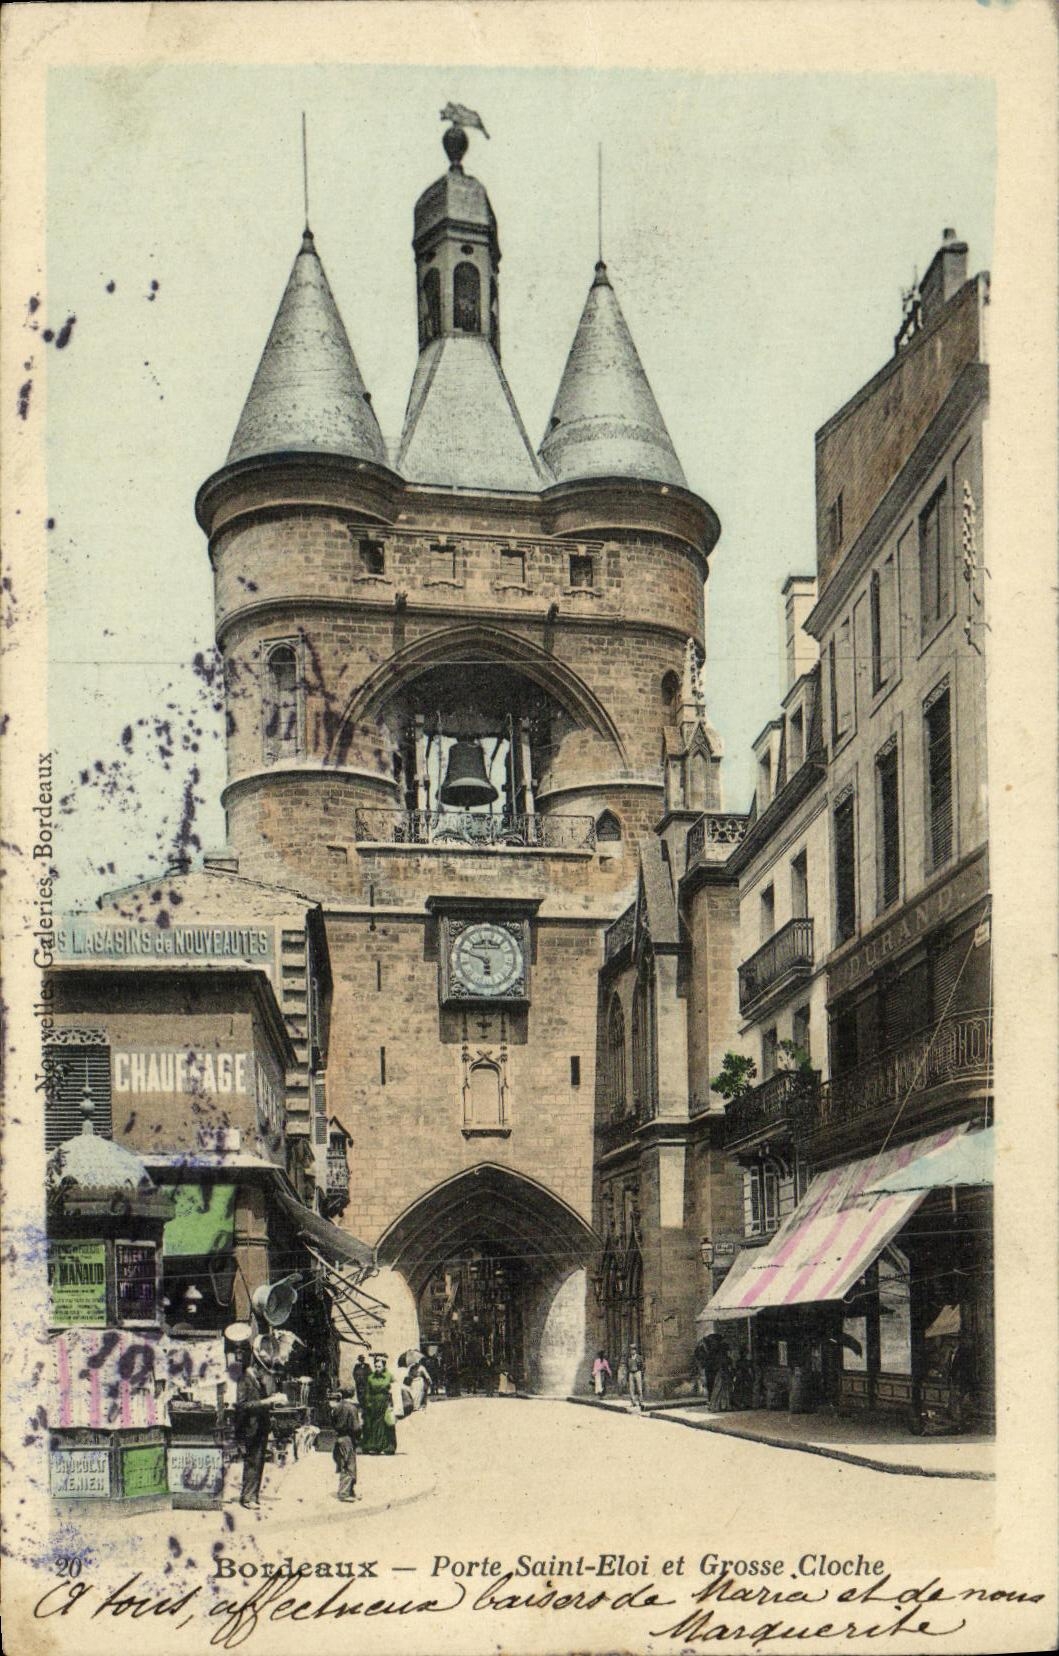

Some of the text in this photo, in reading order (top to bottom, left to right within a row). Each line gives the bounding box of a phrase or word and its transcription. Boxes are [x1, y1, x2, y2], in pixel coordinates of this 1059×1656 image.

[156, 934, 171, 953] de
[472, 1571, 606, 1610] baisers
[611, 1583, 676, 1610] de
[691, 1570, 828, 1605] Maria
[837, 1574, 897, 1603] et
[898, 1577, 955, 1604] de
[649, 1604, 966, 1647] Marguerite
